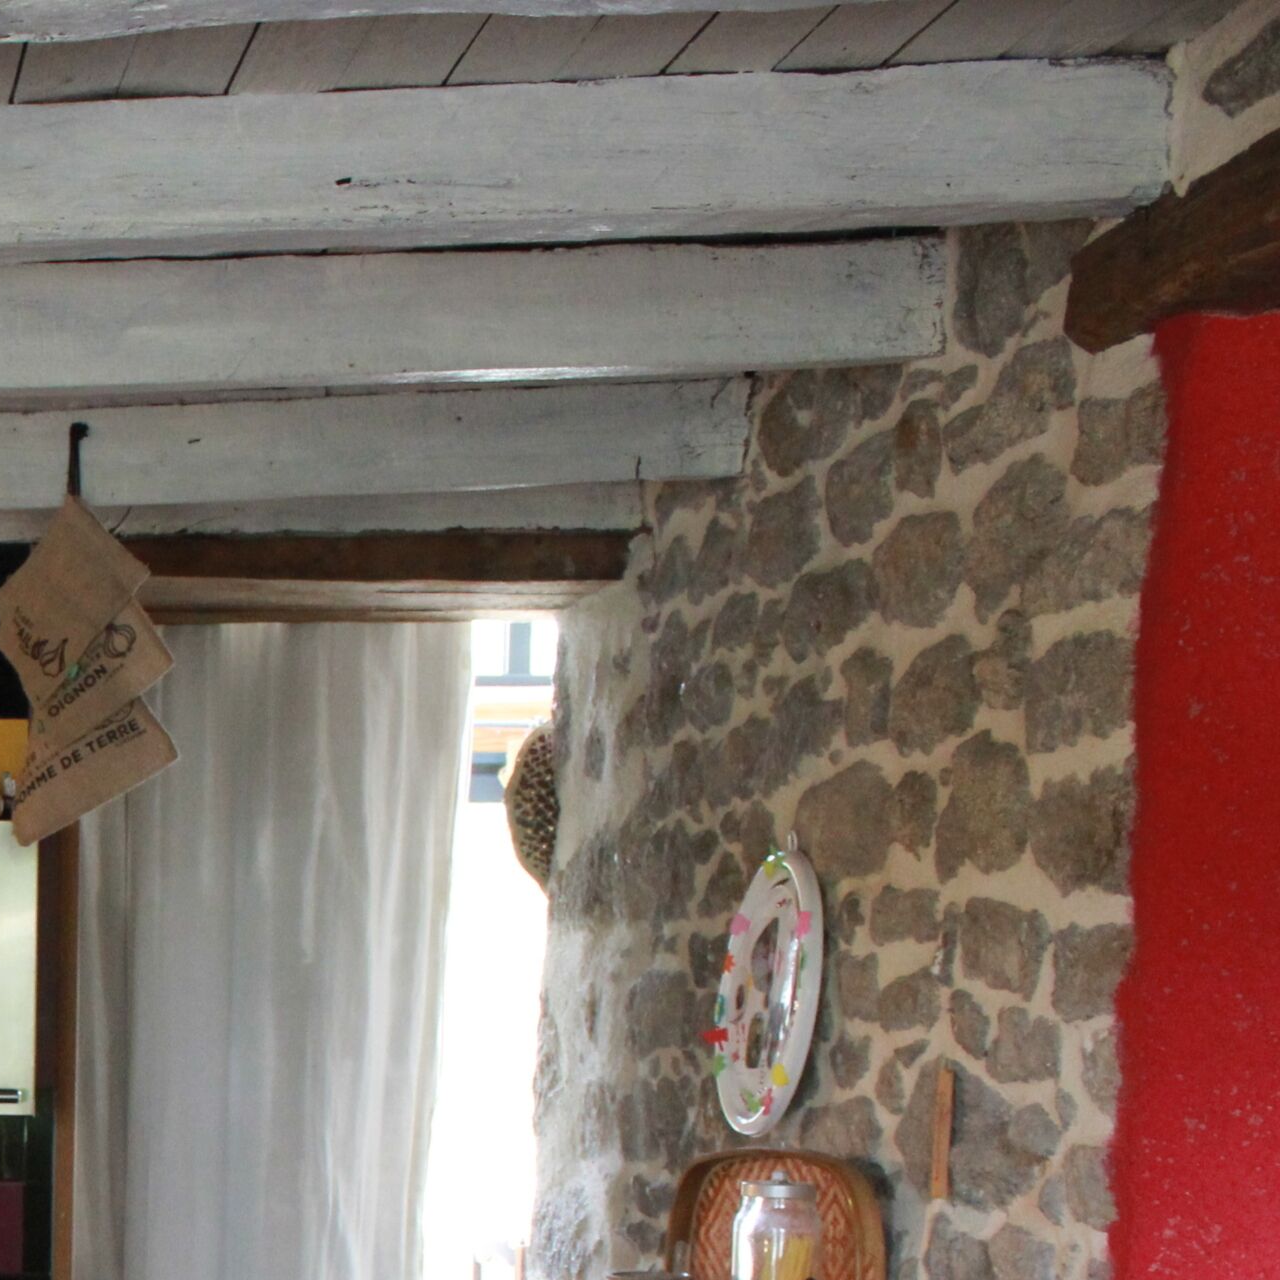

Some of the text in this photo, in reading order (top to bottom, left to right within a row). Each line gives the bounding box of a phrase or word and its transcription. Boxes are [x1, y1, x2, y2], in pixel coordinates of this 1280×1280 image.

[47, 663, 109, 719] OIGNON
[59, 748, 85, 771] DE
[85, 718, 141, 753] TERRE
